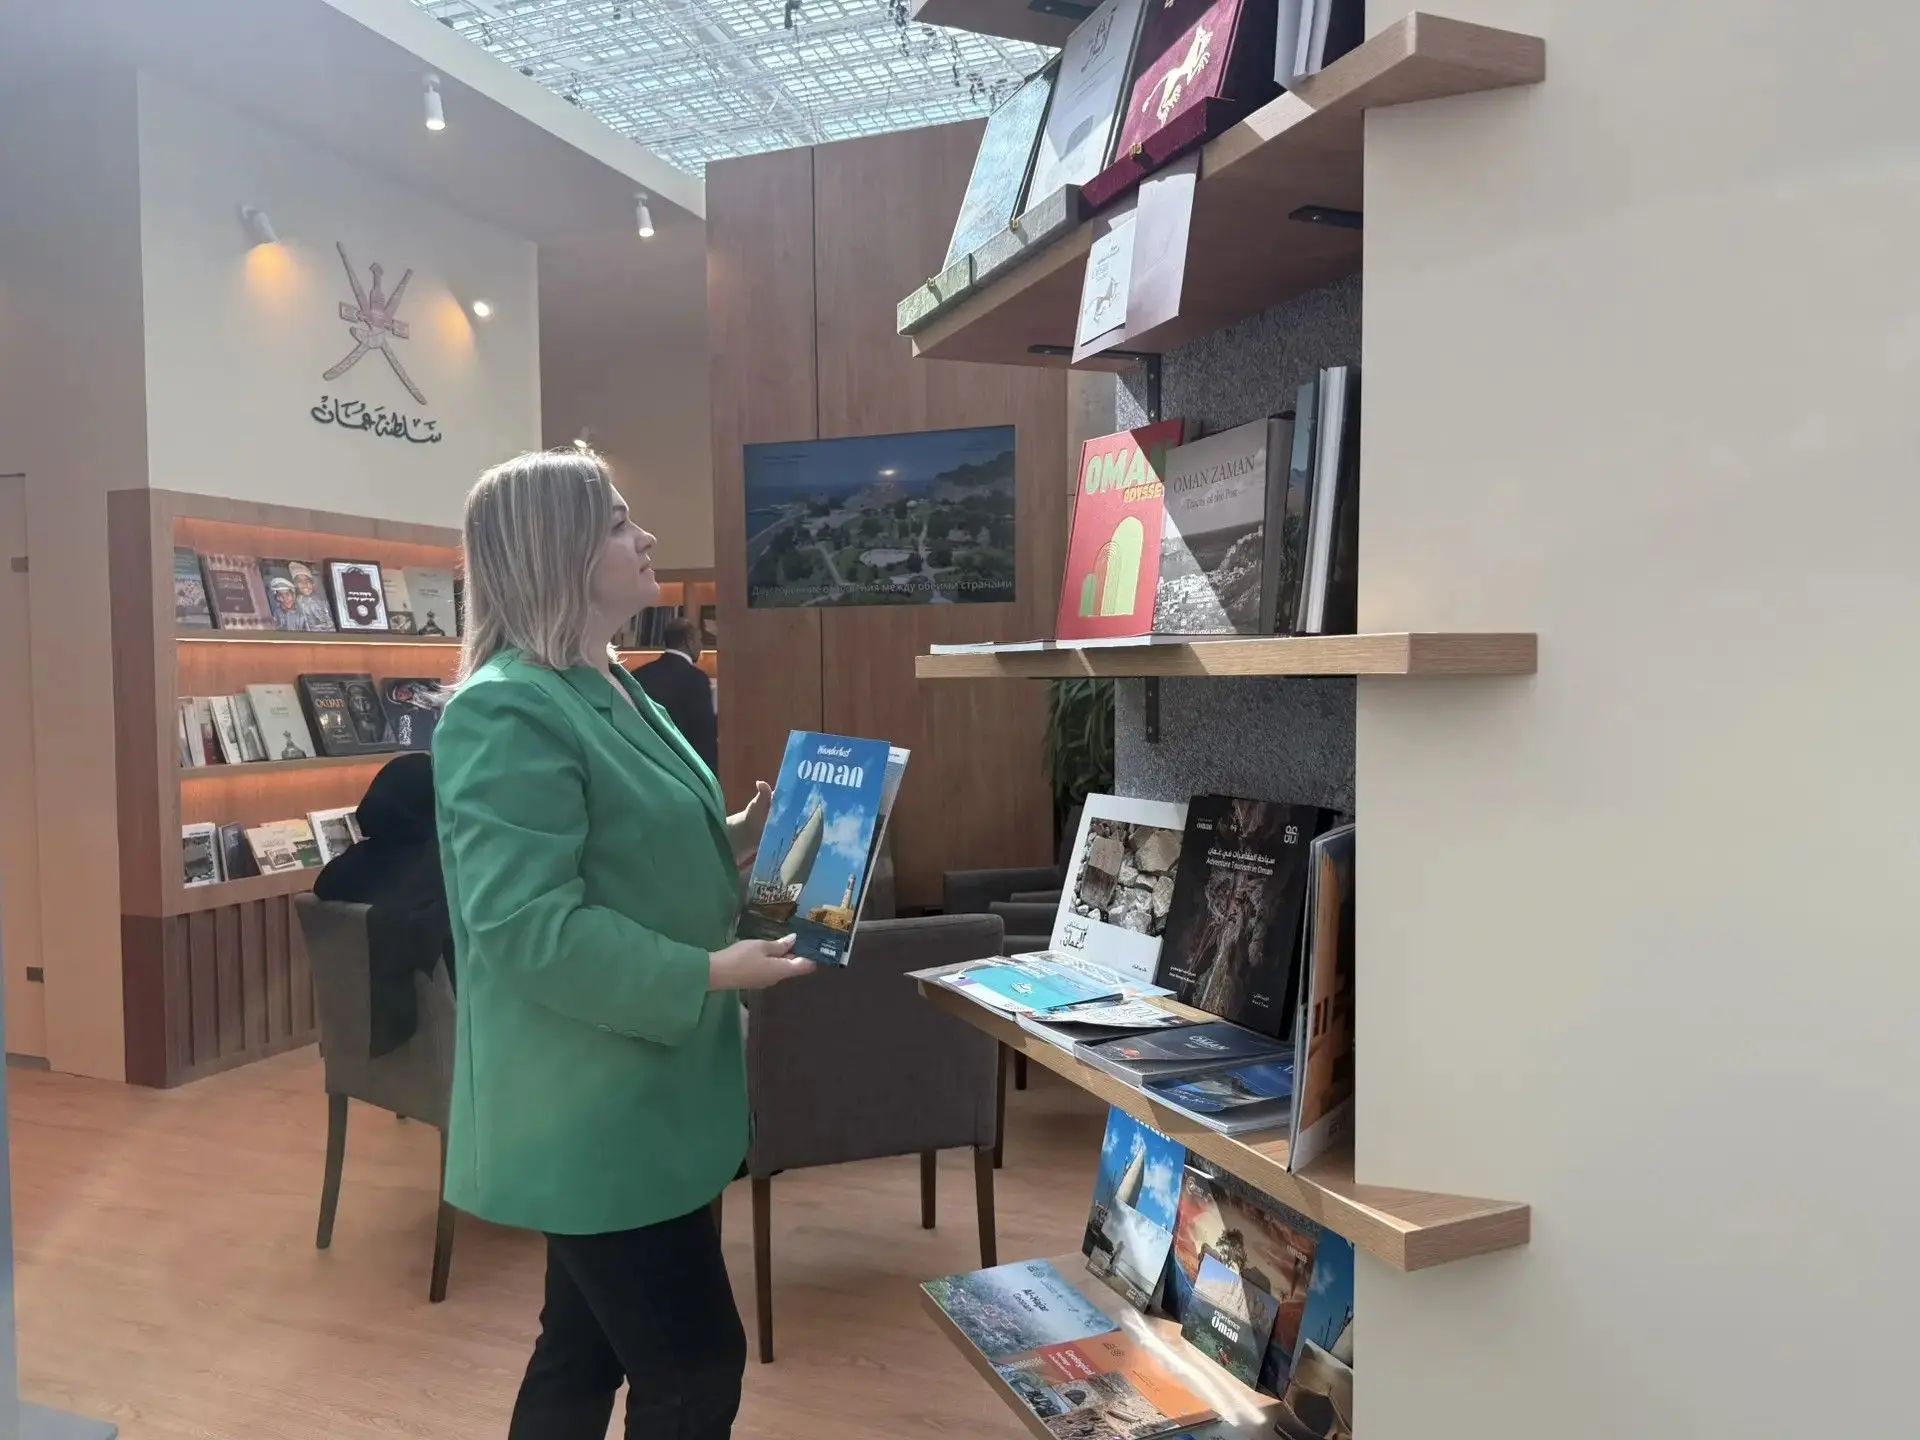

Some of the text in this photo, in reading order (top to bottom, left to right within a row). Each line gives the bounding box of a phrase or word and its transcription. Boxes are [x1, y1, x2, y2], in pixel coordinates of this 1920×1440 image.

[1173, 453, 1257, 494] OMAN ZAMAN
[1123, 481, 1166, 504] ODYSSE
[882, 582, 915, 593] между
[960, 579, 1012, 592] странами
[797, 759, 864, 788] oman
[1205, 857, 1231, 869] Adventure
[1231, 860, 1252, 872] Tourism
[1257, 864, 1274, 876] Oman
